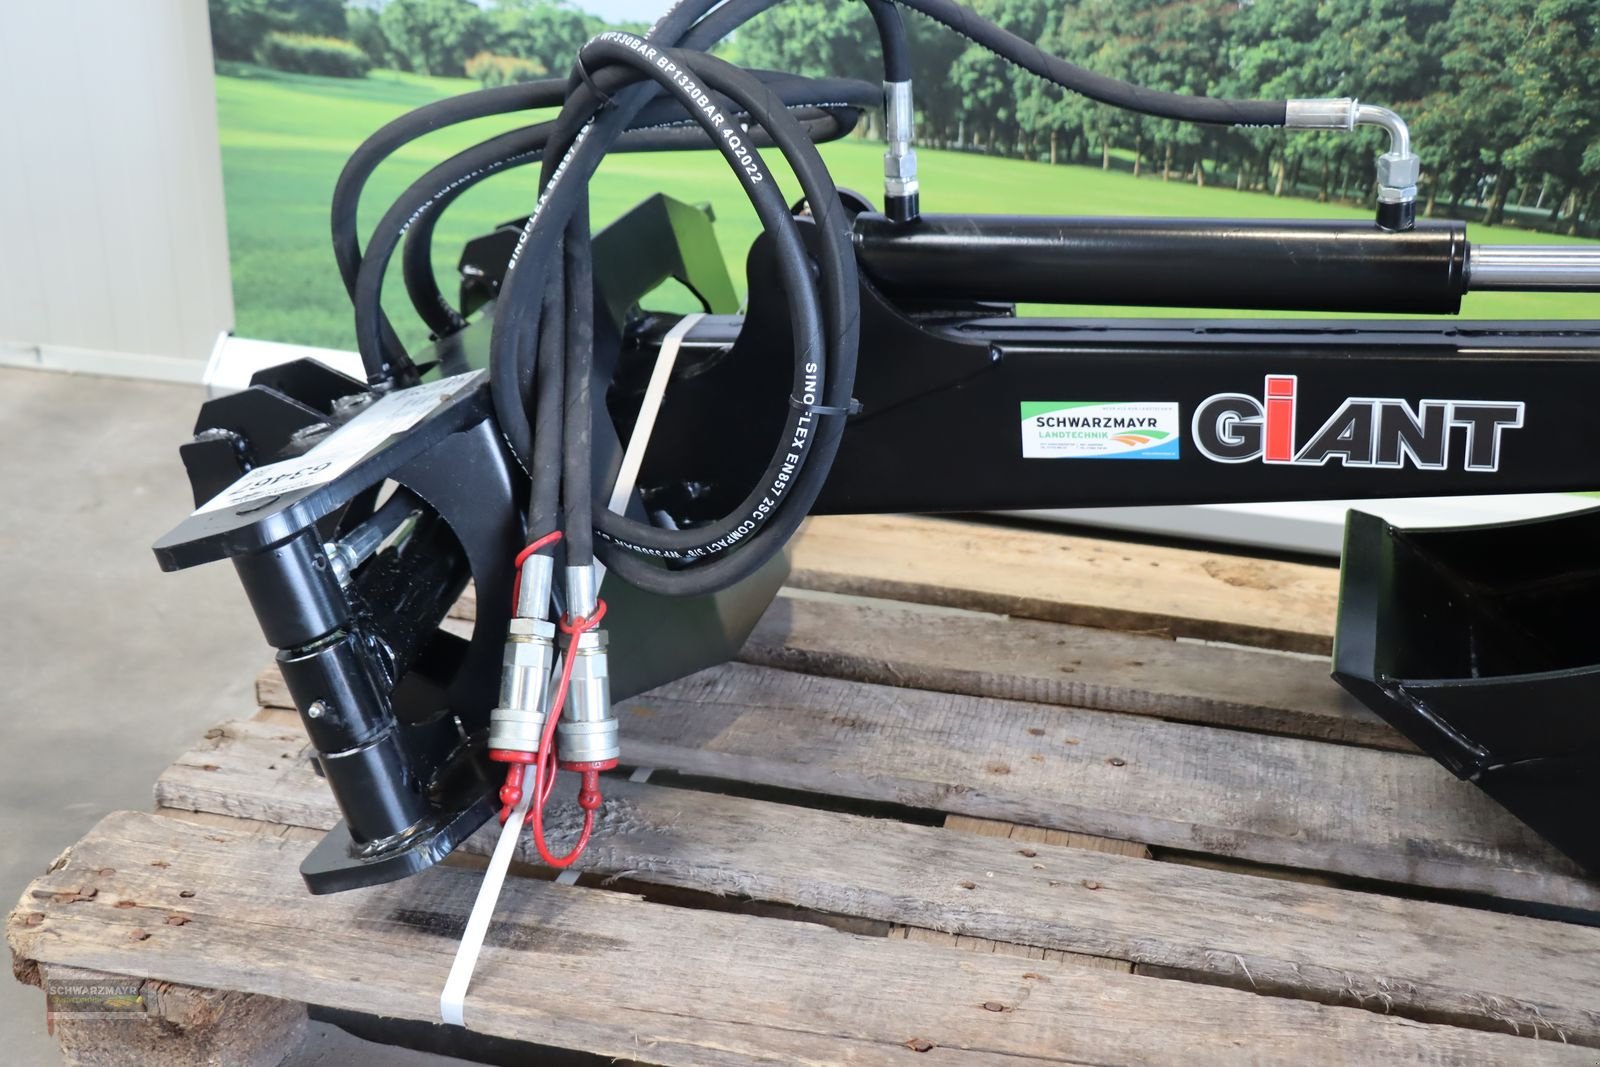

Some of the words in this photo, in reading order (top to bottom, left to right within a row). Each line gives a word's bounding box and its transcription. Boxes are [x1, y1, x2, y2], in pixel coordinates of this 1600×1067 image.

[656, 56, 725, 127] BP1320BAR
[721, 128, 763, 184] 4Q2022
[1036, 417, 1158, 428] SCHWARZMAYR
[1038, 431, 1109, 439] LANDTECHNIK
[771, 453, 799, 496] EN857
[752, 497, 775, 520] 2SC
[706, 520, 756, 553] COMPACT
